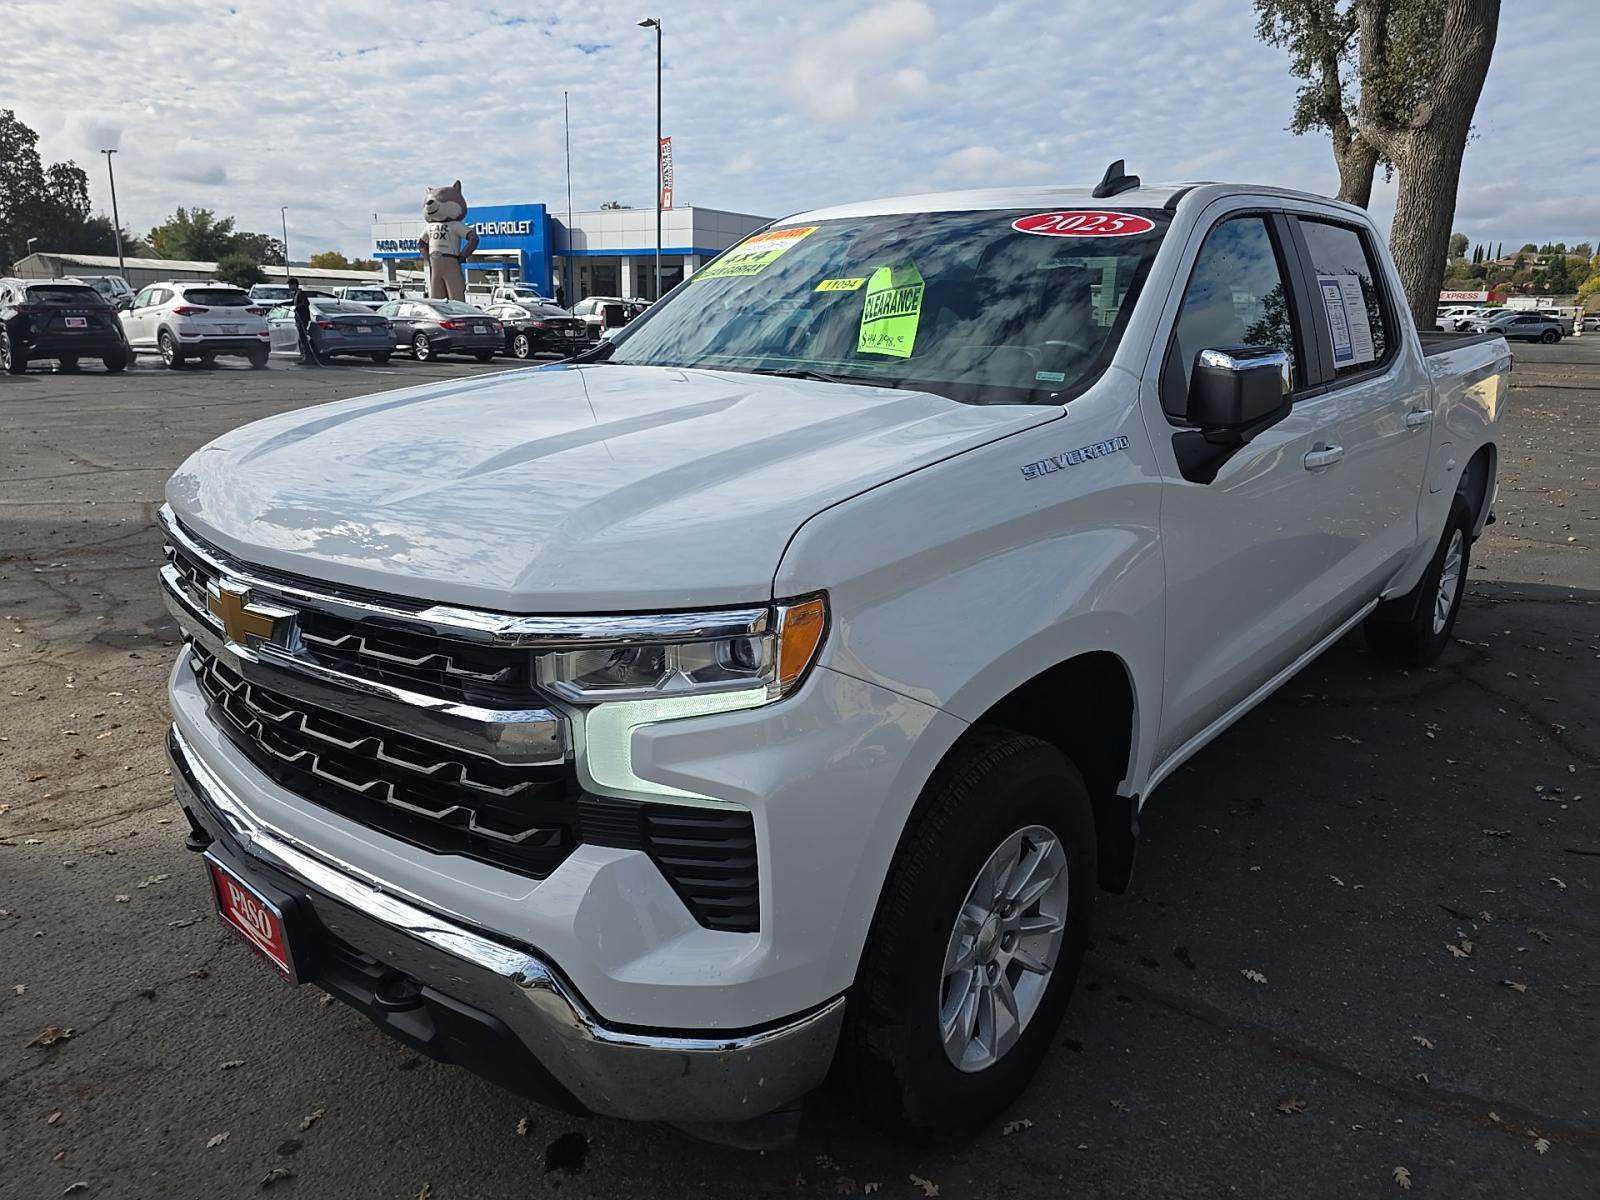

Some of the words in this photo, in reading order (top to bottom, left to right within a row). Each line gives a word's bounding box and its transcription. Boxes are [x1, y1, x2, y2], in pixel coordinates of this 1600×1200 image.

[475, 220, 531, 236] CHEVROLET
[1030, 215, 1134, 232] 2025
[429, 232, 447, 240] FOX
[824, 280, 857, 290] 11094
[864, 286, 922, 319] CLEARANCE
[1440, 292, 1479, 300] EXPRESS
[1021, 436, 1130, 480] SILVERADO
[228, 881, 273, 940] PASO
